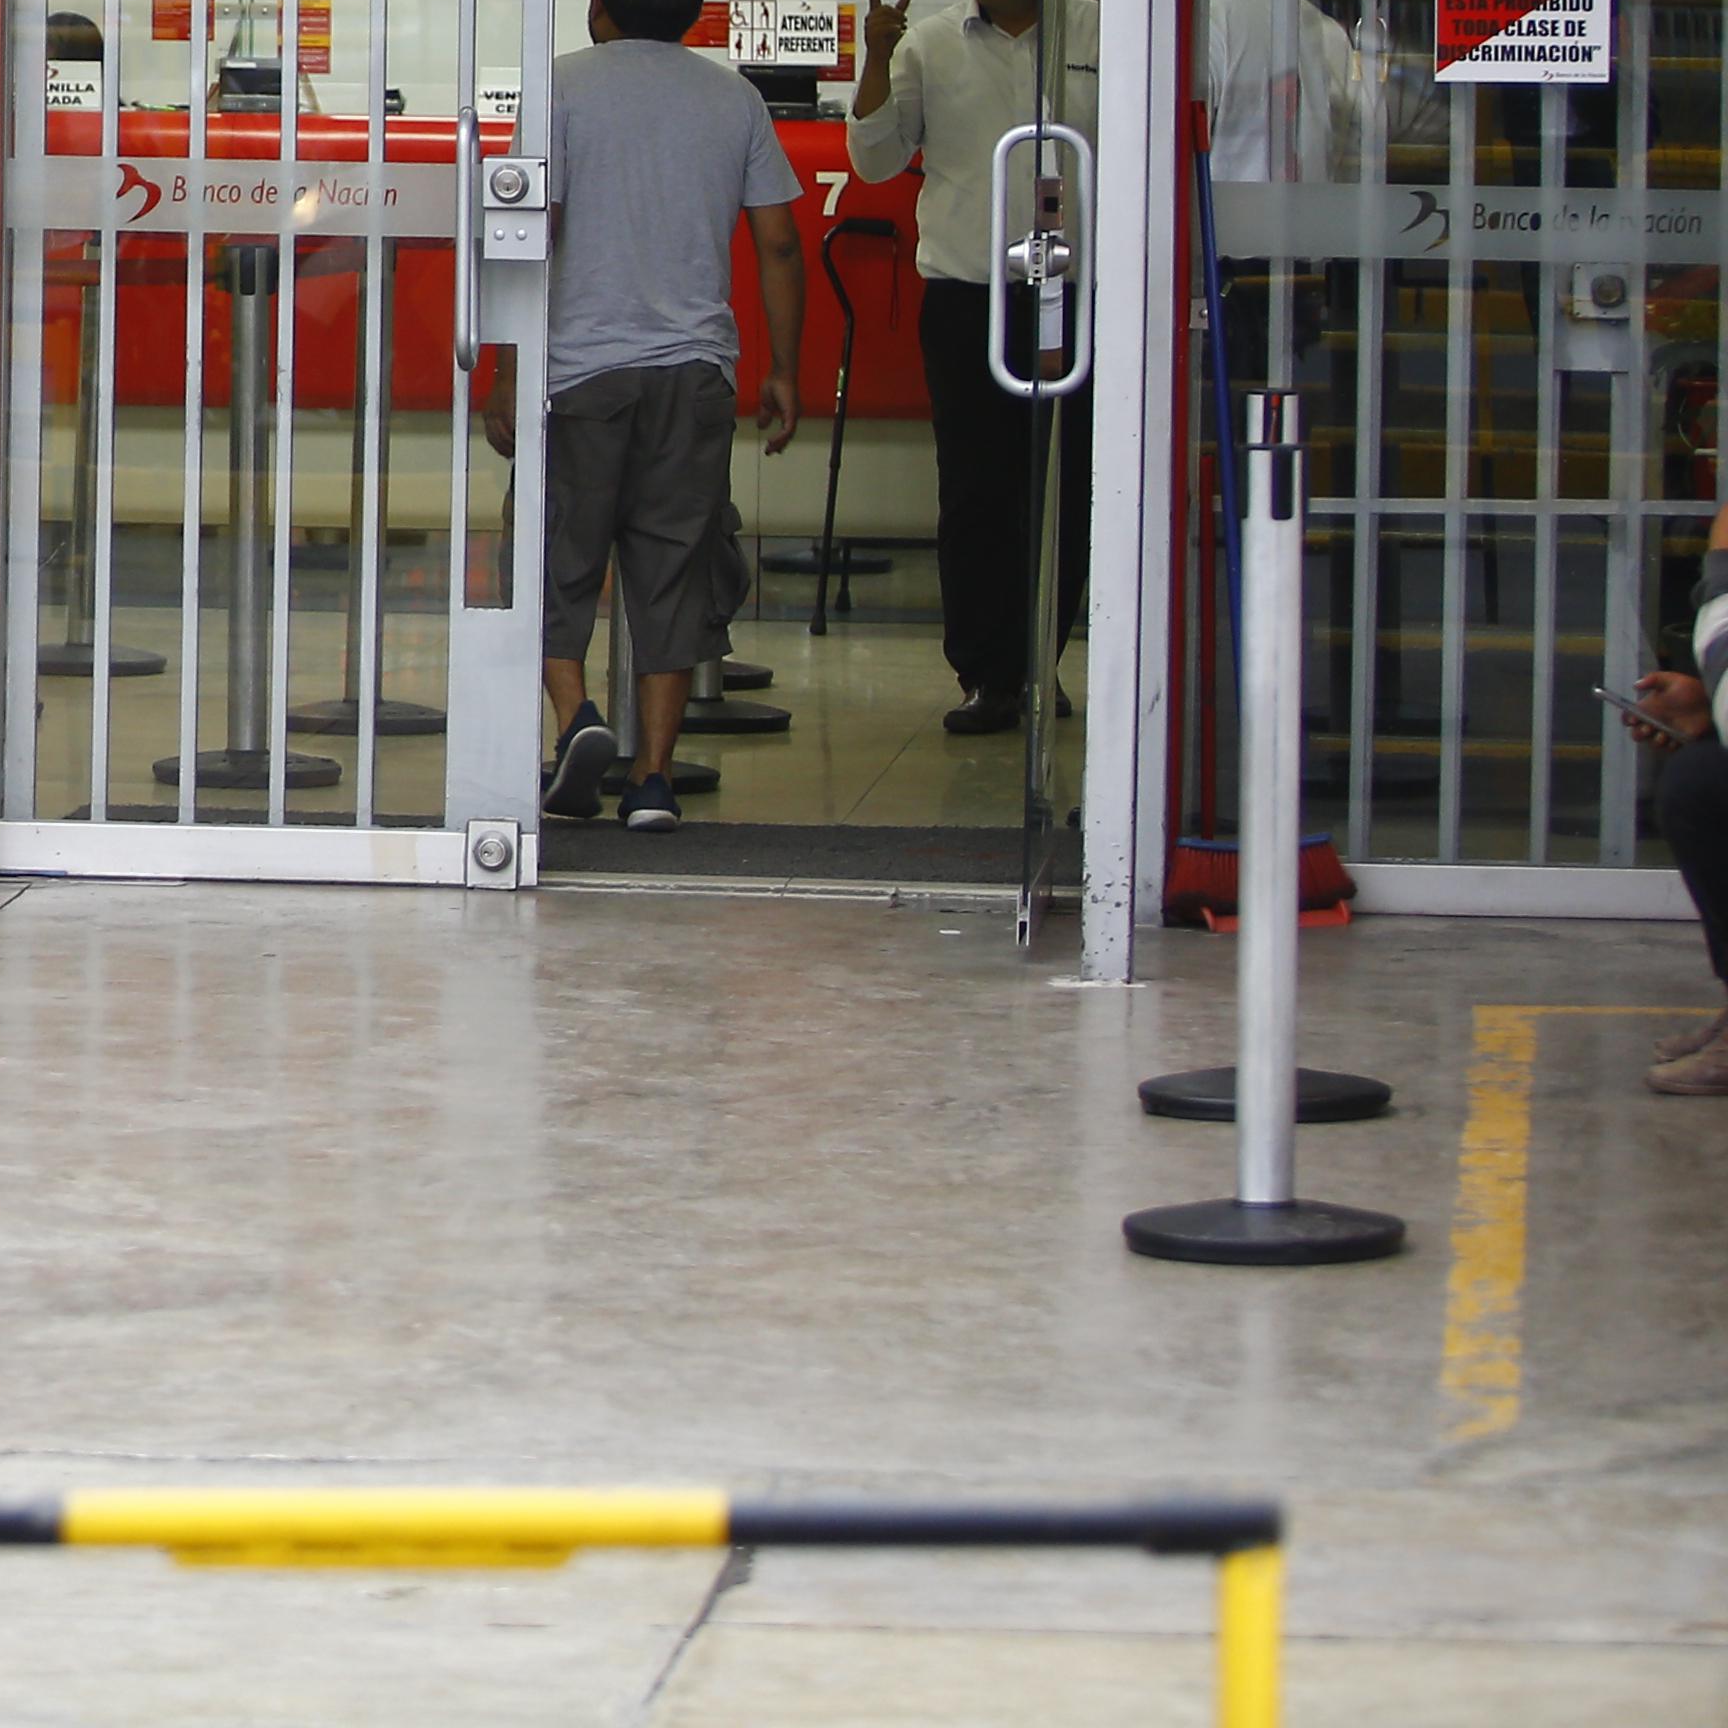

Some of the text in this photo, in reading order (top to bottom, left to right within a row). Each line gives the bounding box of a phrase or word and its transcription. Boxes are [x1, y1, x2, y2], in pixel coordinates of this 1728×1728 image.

[780, 12, 834, 33] ATENCIÓN
[1453, 18, 1587, 38] TODA CLASE DE
[777, 35, 837, 54] PREFERENTE
[171, 175, 397, 208] Bnco de Nacin
[815, 171, 850, 217] 7
